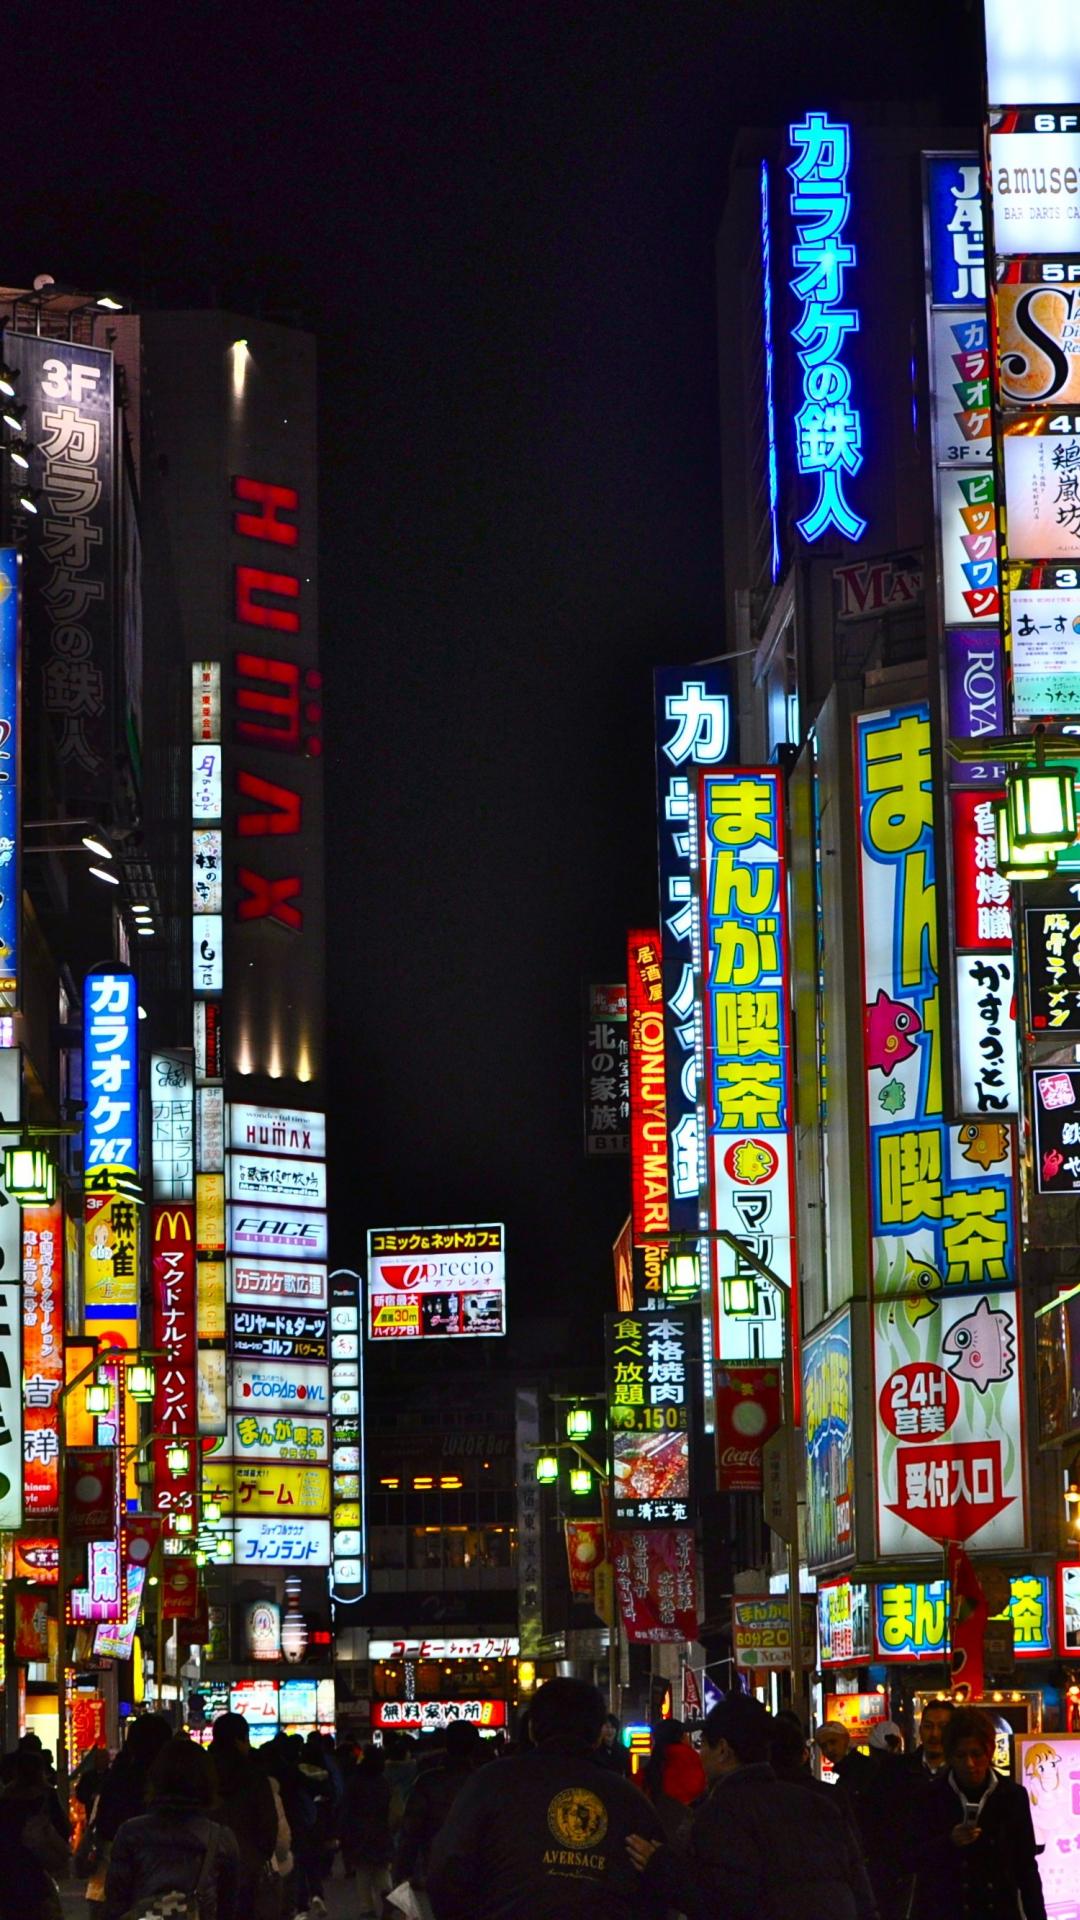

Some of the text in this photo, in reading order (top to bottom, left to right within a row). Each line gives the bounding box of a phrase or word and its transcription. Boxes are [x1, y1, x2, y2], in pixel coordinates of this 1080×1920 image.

[1034, 115, 1077, 132] 6F
[998, 167, 1080, 194] amuse
[790, 113, 867, 542] カラオケの鉄人
[41, 358, 101, 402] 3F
[963, 323, 988, 439] カラオケ
[968, 477, 996, 615] ビックワン
[38, 404, 105, 775] カラオケの鉄人
[1016, 613, 1068, 637] あーす
[710, 781, 782, 1128] まんが喫茶
[637, 946, 662, 1001] 居酒屋
[90, 975, 130, 1134] カラオケ
[969, 960, 1010, 1112] かすうどん
[589, 1024, 617, 1130] 北の家族
[89, 1138, 132, 1163] 747
[87, 1198, 104, 1209] 3F
[111, 1201, 135, 1277] 麻雀
[236, 1218, 324, 1238] FACE
[161, 1252, 187, 1362] マクドナルド
[262, 1340, 293, 1355] ゴルフ
[613, 1318, 645, 1405] 食べ放題
[647, 1318, 686, 1404] 本格焼肉
[891, 1372, 947, 1409] 24H
[237, 1417, 324, 1447] まんが喫茶
[895, 1406, 946, 1435] 営業
[24, 1483, 52, 1492] hinese
[239, 1481, 294, 1505] ゲーム
[905, 1458, 995, 1509] 受付入口
[25, 1506, 60, 1515] elaxation
[245, 1540, 320, 1560] フィンランド
[234, 1703, 275, 1716] ゲーム
[381, 1701, 482, 1721] 無料案内所
